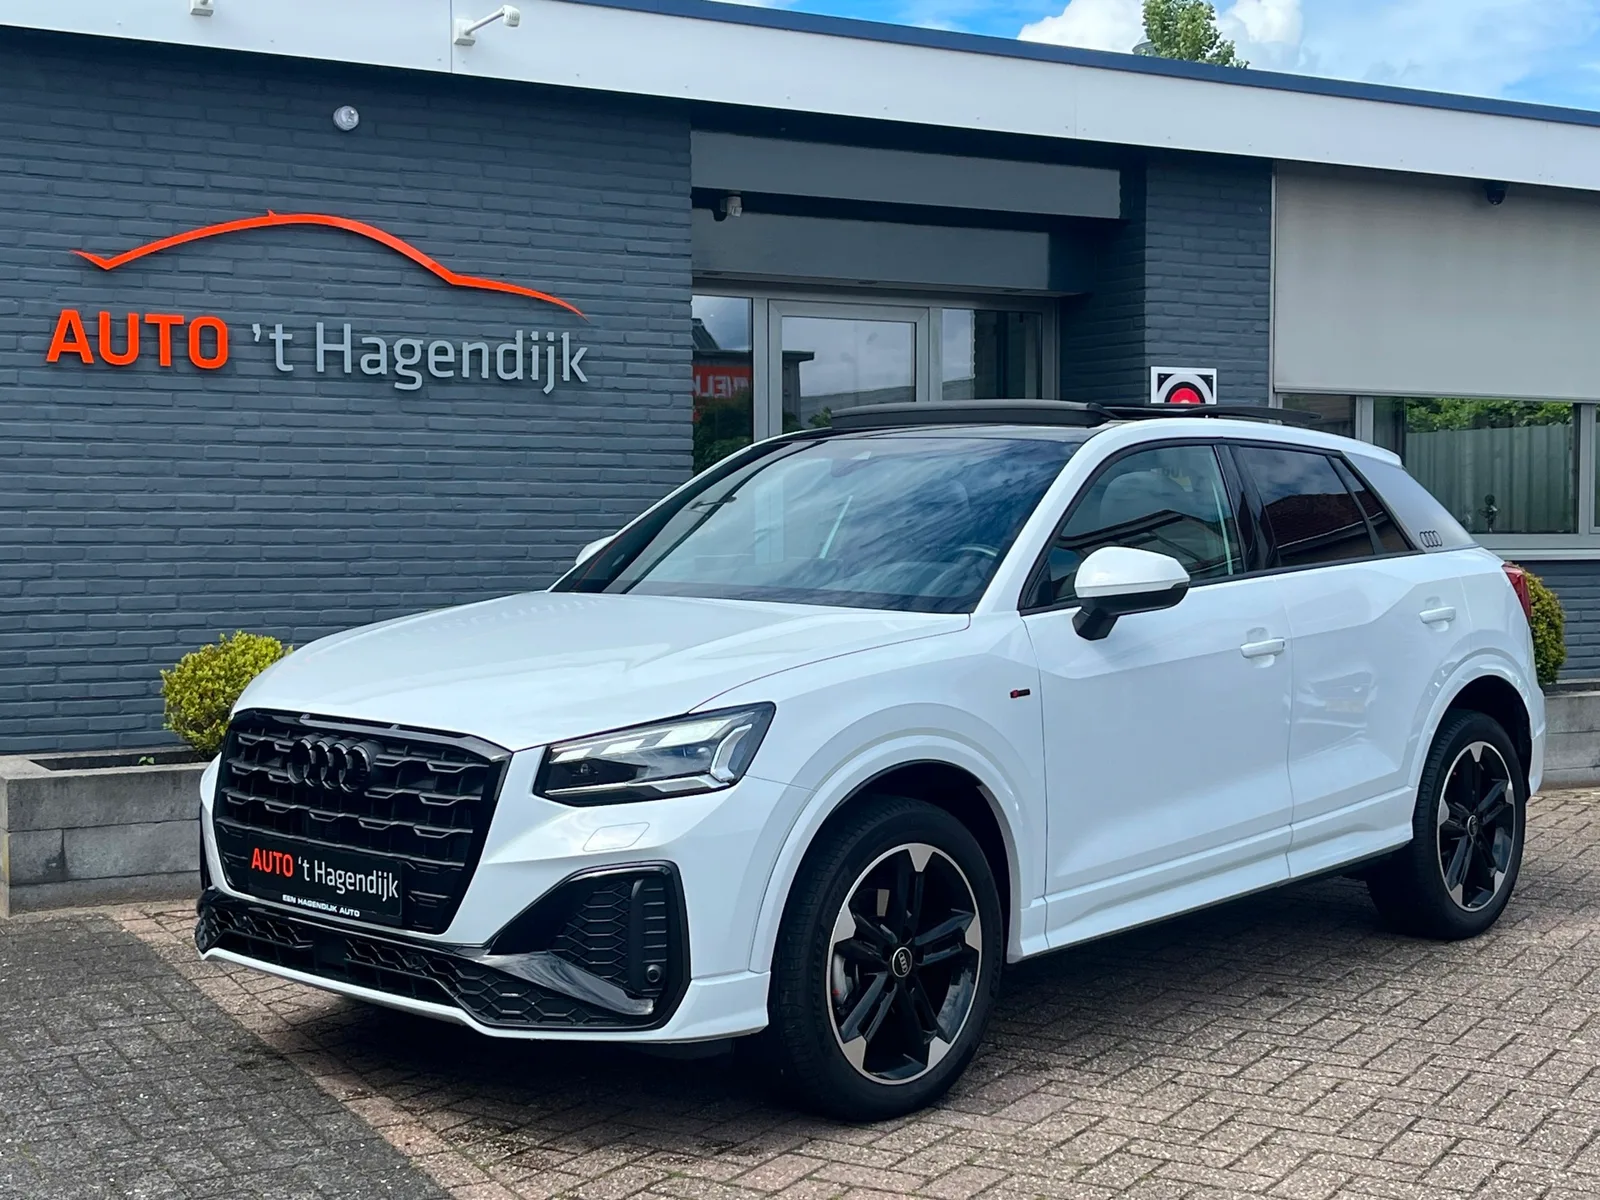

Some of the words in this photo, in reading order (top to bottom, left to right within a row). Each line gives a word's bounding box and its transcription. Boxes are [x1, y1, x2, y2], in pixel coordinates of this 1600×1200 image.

[46, 308, 230, 370] AUTO
[316, 321, 588, 394] Hagendijk
[251, 847, 294, 878] AUTO
[314, 859, 399, 903] Hagendijk
[282, 894, 297, 904] EEN
[297, 897, 338, 913] HAGENDIJK
[339, 907, 361, 918] AUTO
